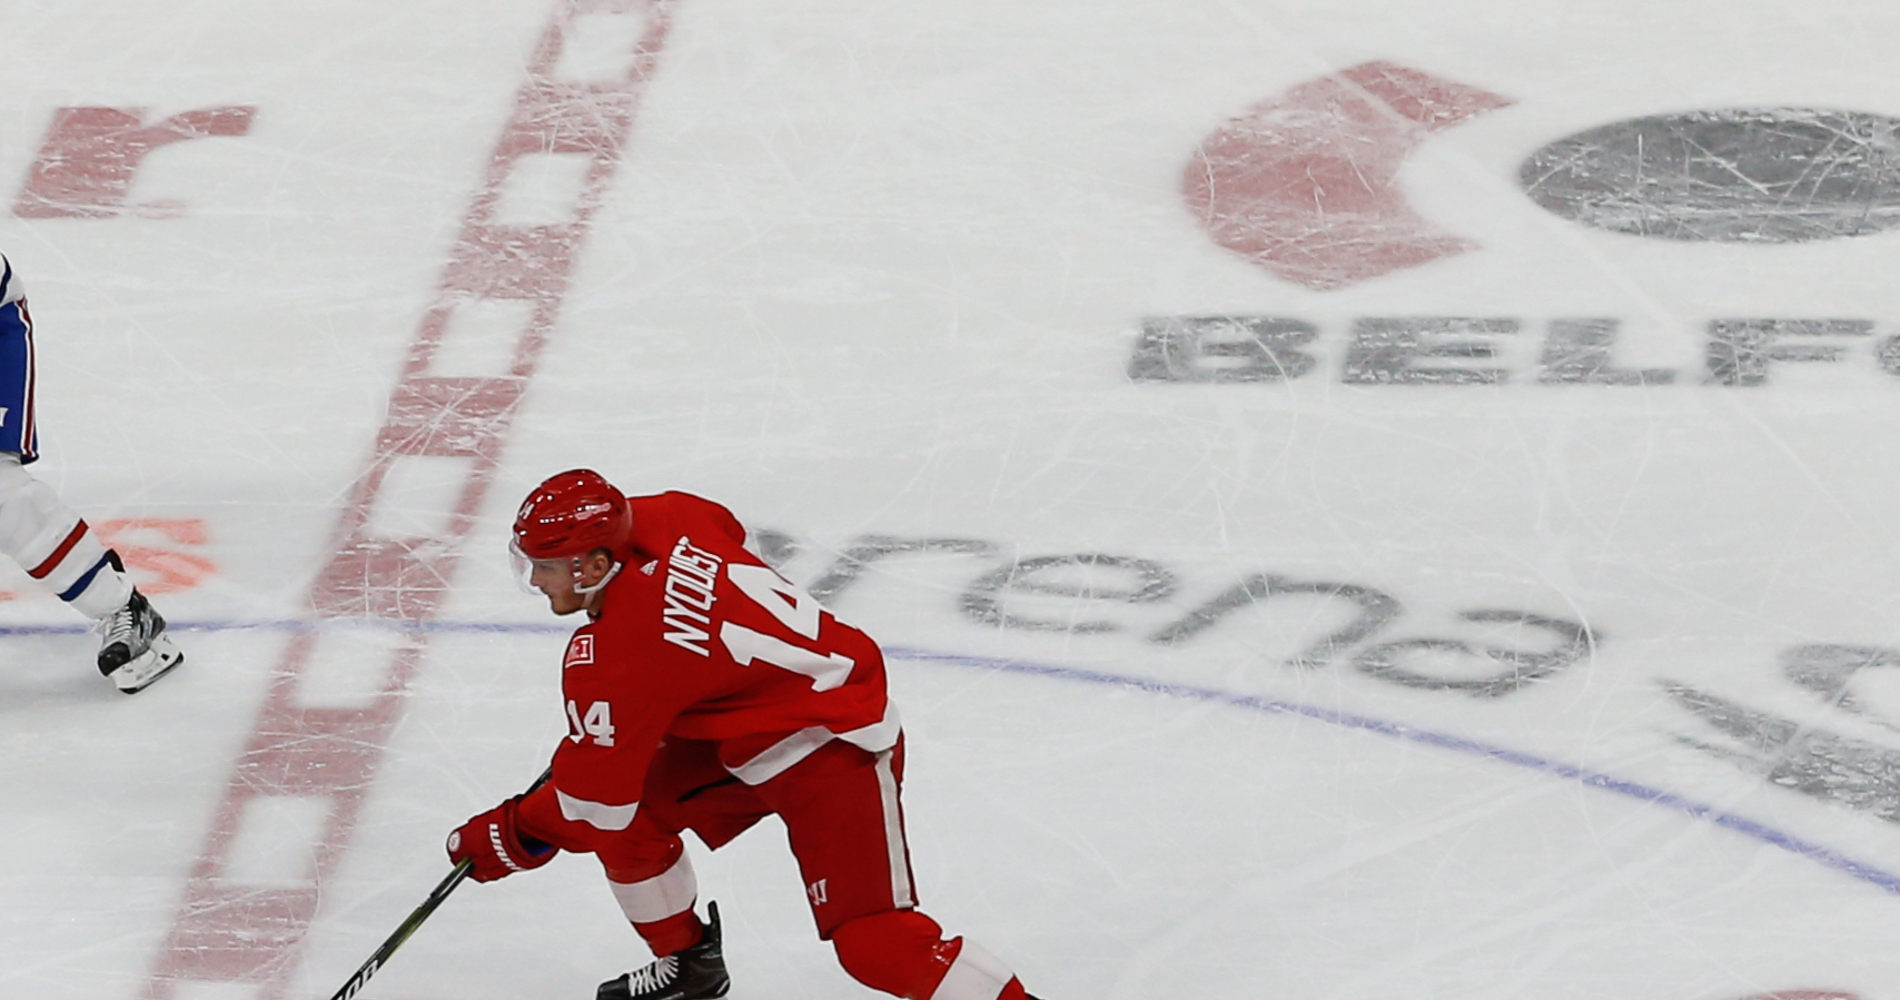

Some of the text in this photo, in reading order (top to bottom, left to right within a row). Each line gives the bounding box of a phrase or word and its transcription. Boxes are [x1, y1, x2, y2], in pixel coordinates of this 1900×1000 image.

[1123, 314, 1900, 388] BELF
[663, 535, 723, 658] NYQUIST
[719, 563, 856, 693] 14
[752, 526, 1607, 700] rena
[567, 699, 616, 747] 14
